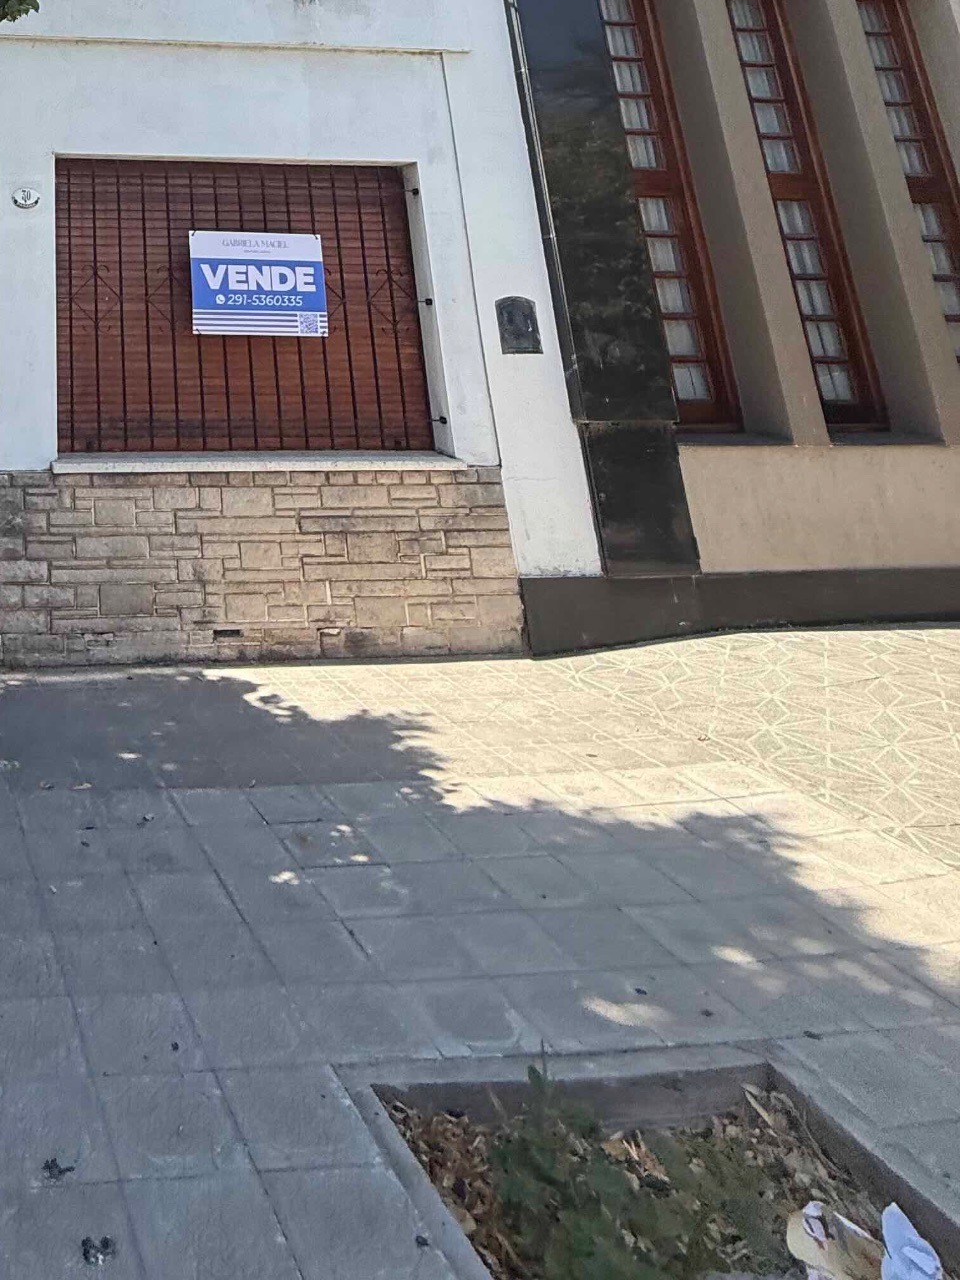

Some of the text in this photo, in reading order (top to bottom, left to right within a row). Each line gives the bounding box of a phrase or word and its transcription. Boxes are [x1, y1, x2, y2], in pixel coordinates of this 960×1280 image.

[222, 239, 260, 248] GABRIELA
[200, 263, 316, 292] VENDE
[227, 294, 303, 306] 291-5360335
